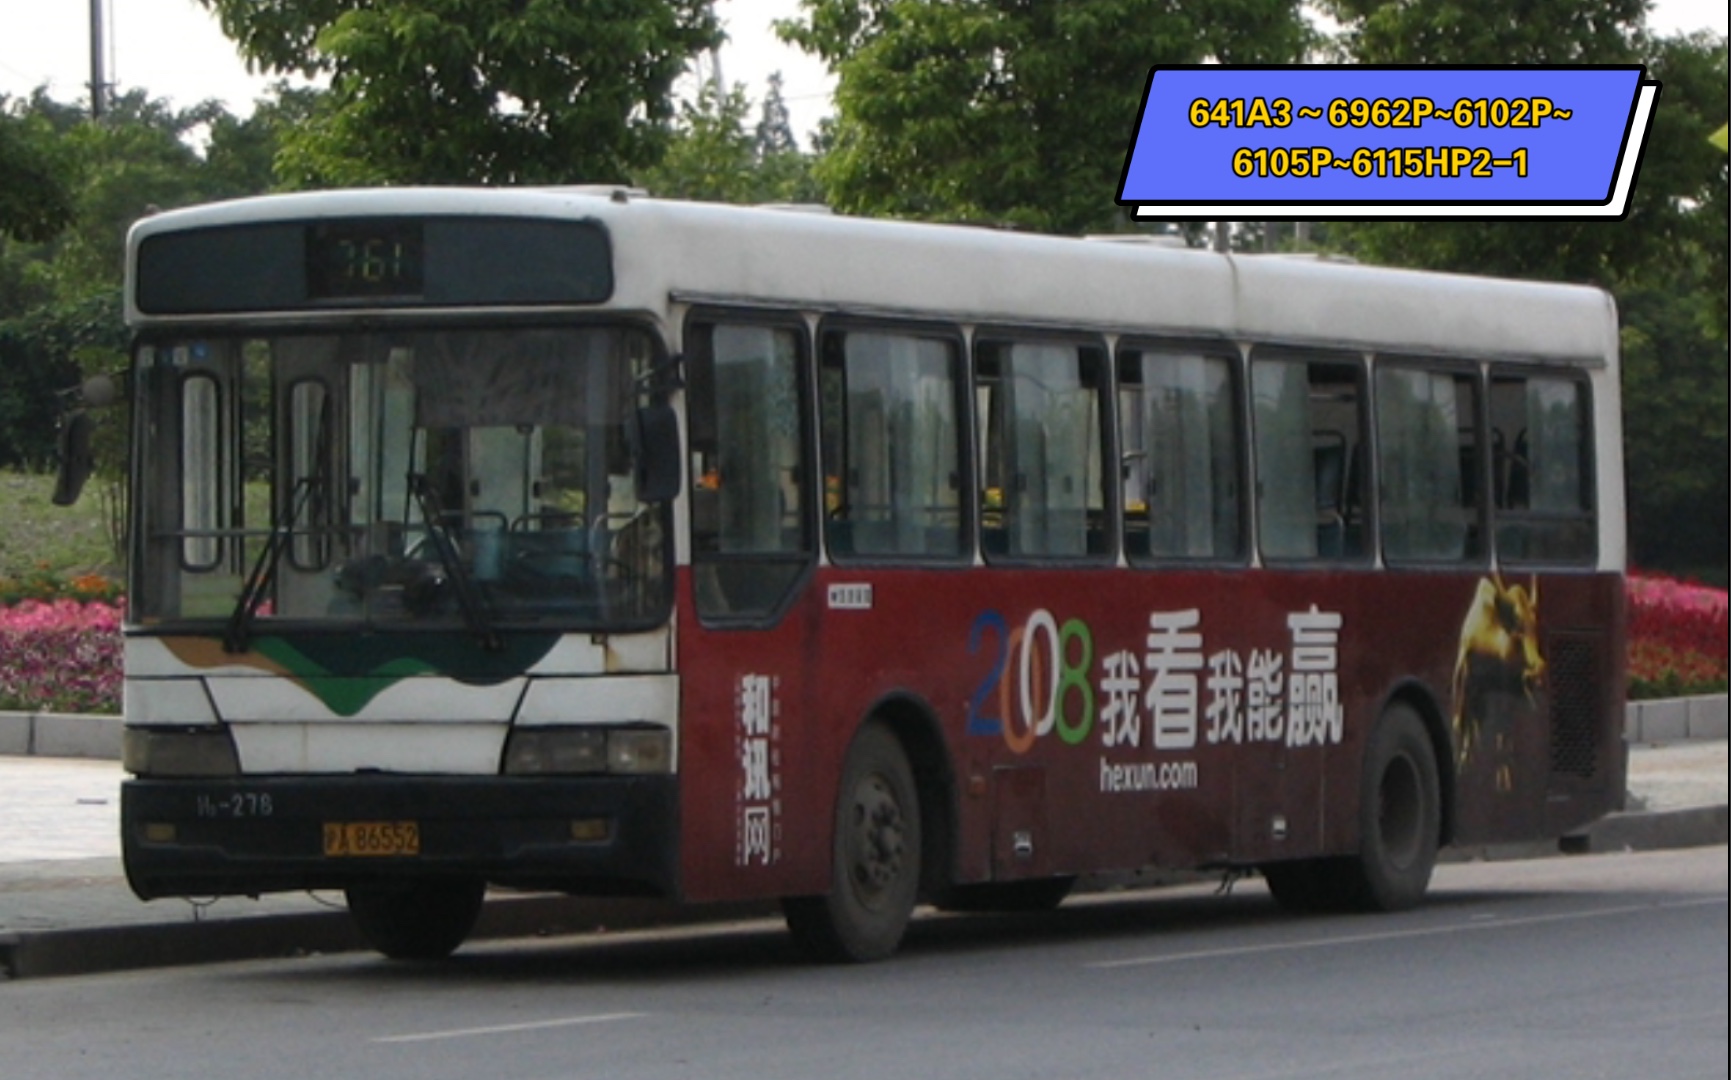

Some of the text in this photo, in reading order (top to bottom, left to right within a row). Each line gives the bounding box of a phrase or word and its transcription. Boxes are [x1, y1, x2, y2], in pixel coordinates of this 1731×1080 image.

[1100, 603, 1343, 749] 我看我能赢
[742, 673, 771, 865] 和讯网
[1100, 757, 1198, 791] hexun.com
